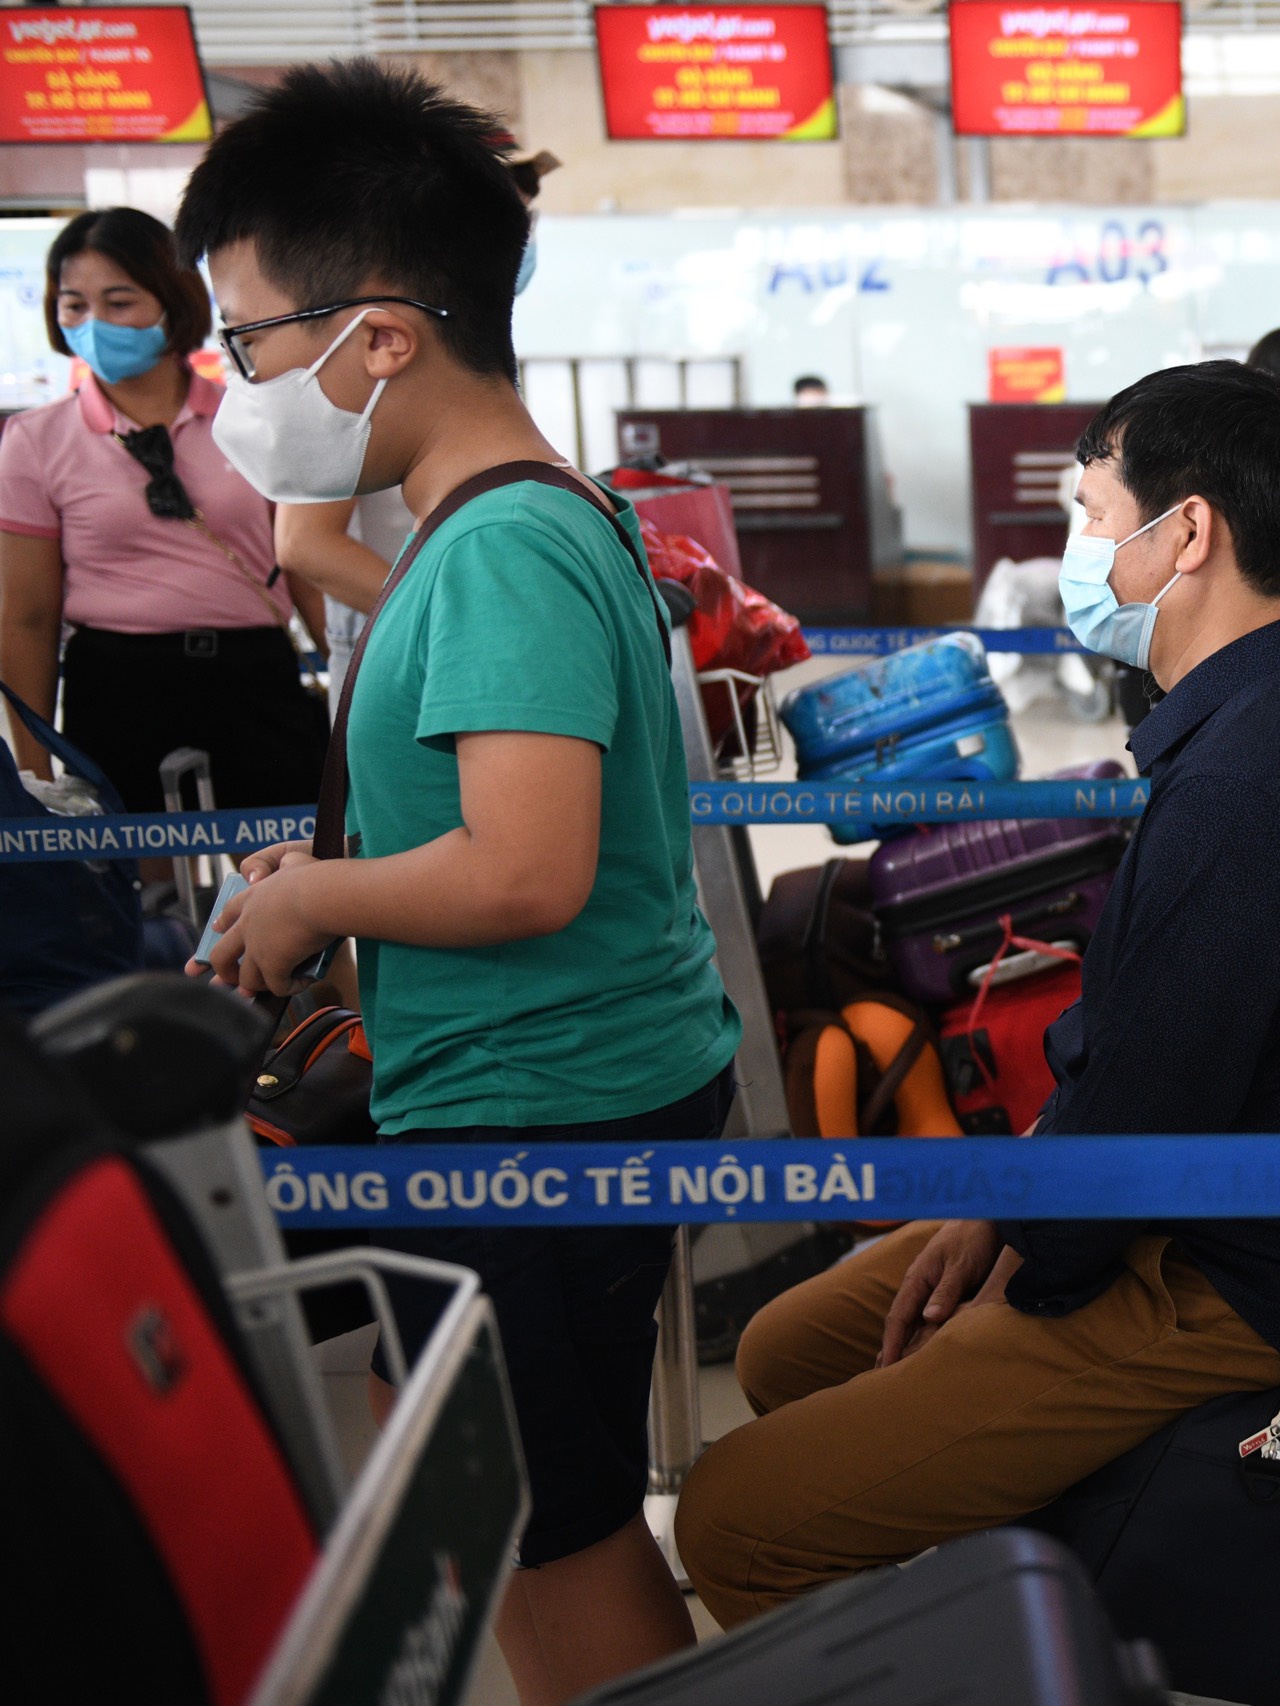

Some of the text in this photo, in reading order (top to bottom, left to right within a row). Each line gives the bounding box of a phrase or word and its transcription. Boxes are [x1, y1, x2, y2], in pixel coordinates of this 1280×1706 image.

[406, 1151, 569, 1210] QUỐC
[584, 1150, 655, 1206] TẾ
[669, 1154, 765, 1216] NỘI
[784, 1152, 875, 1203] BÀI
